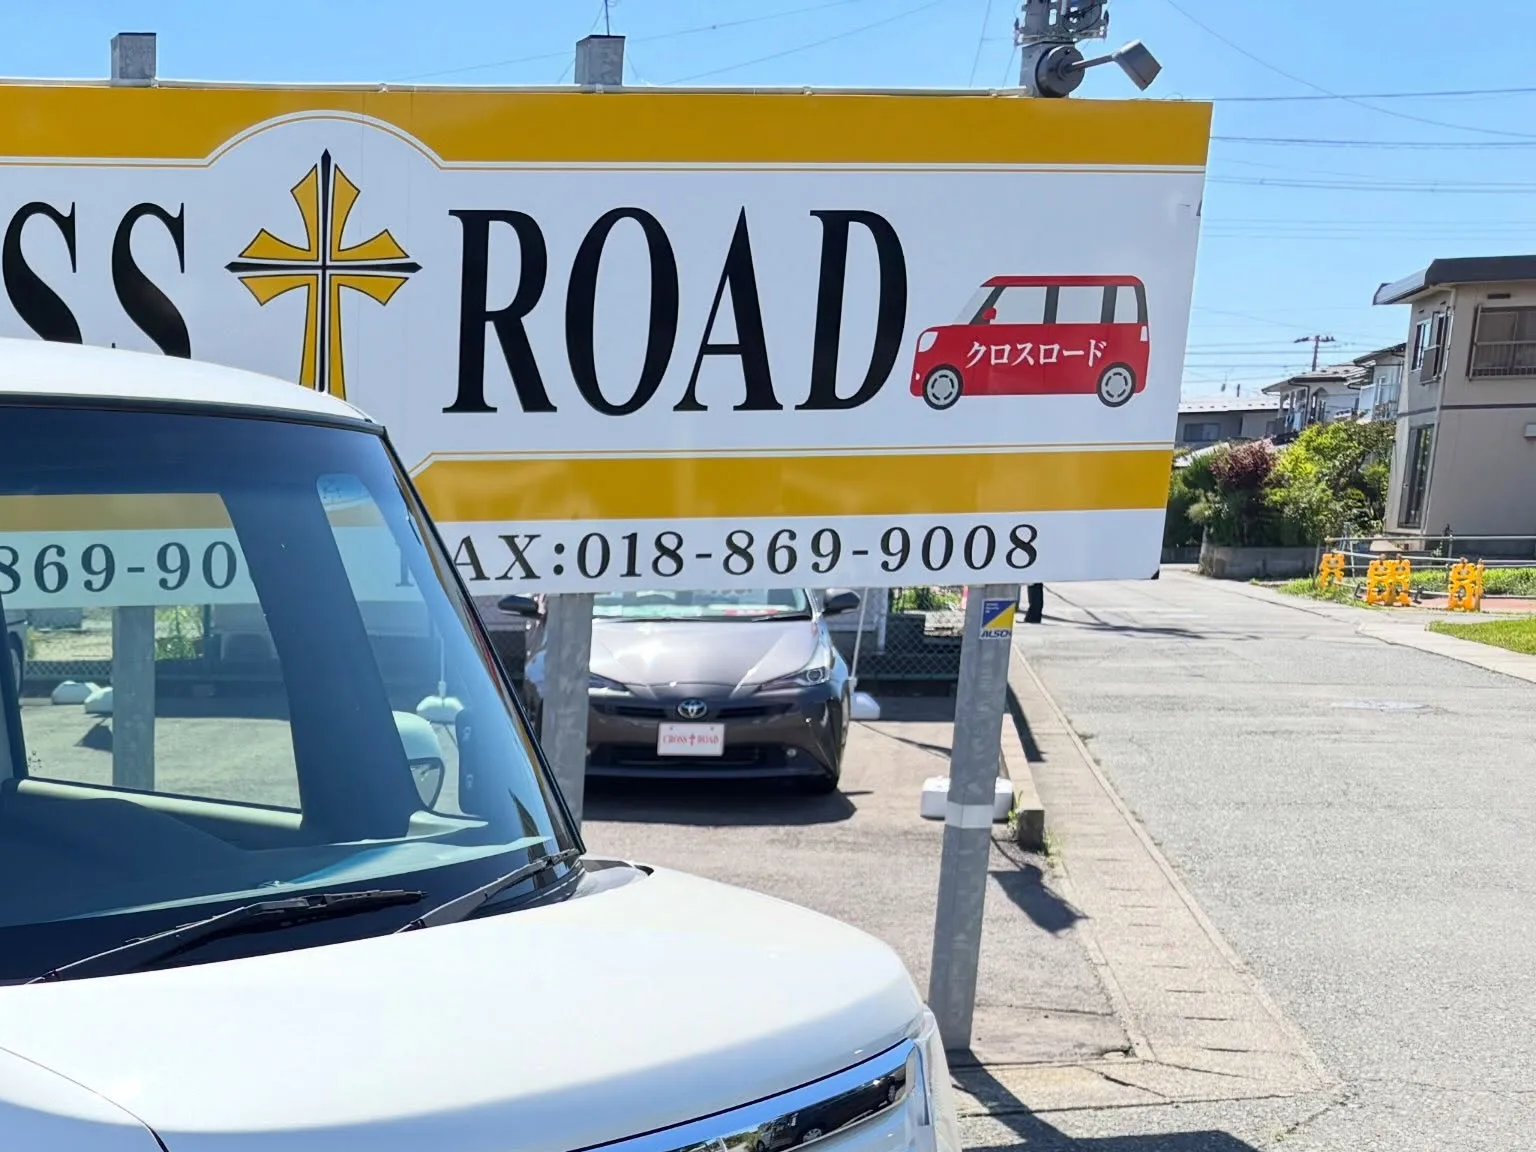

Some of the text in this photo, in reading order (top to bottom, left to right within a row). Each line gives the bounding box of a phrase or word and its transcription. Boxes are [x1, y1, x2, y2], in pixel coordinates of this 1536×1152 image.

[443, 205, 907, 417] ROAD
[965, 339, 1107, 368] クロスロード
